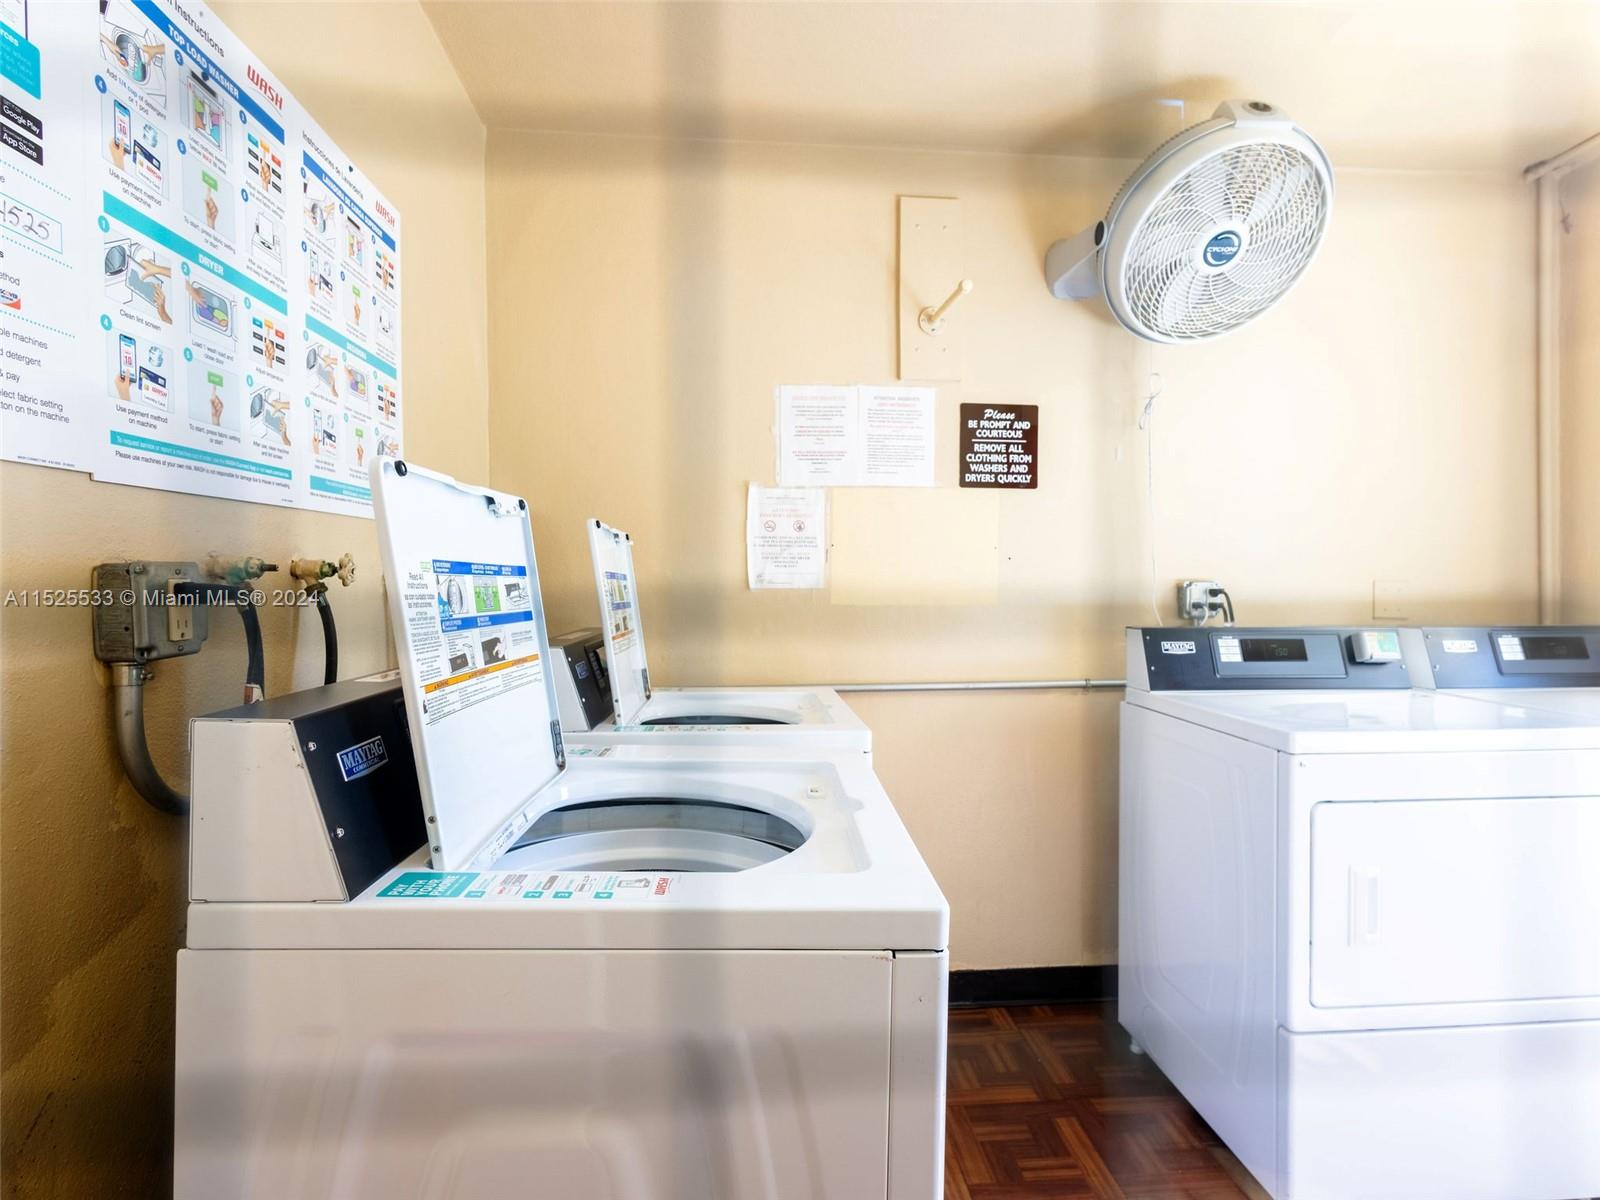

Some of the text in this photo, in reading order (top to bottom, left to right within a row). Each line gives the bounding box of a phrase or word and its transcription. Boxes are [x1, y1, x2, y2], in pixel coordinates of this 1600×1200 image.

[174, 0, 225, 58] Instructions
[167, 24, 240, 100] TOP LOAD WASHER
[246, 64, 284, 110] WASH
[3, 105, 40, 135] Google Play
[3, 132, 38, 159] App Store
[375, 200, 396, 228] WASH
[198, 252, 225, 277] DRYER
[119, 308, 136, 321] Clean
[144, 320, 163, 332] screen
[12, 332, 48, 350] machines
[6, 350, 42, 367] detergent
[6, 371, 21, 383] pay
[17, 391, 39, 405] fabric
[40, 399, 64, 413] setting
[15, 405, 25, 414] on
[26, 406, 39, 417] the
[40, 410, 70, 424] machine
[116, 403, 168, 424] Use payment method
[983, 409, 1016, 420] Please
[128, 417, 158, 430] on machine
[968, 420, 1031, 430] BE PROMPT AND
[976, 429, 1023, 439] COURTEOUS
[974, 443, 1024, 453] REMOVE ALL
[966, 453, 1033, 464] CLOTHING FROM
[969, 463, 1029, 473] WASHERS AND
[965, 473, 1033, 484] DRYERS QUICKLY
[341, 740, 383, 770] MAYTAG
[400, 879, 426, 896] WITH
[413, 879, 441, 896] YOUR
[654, 877, 670, 896] WASH
